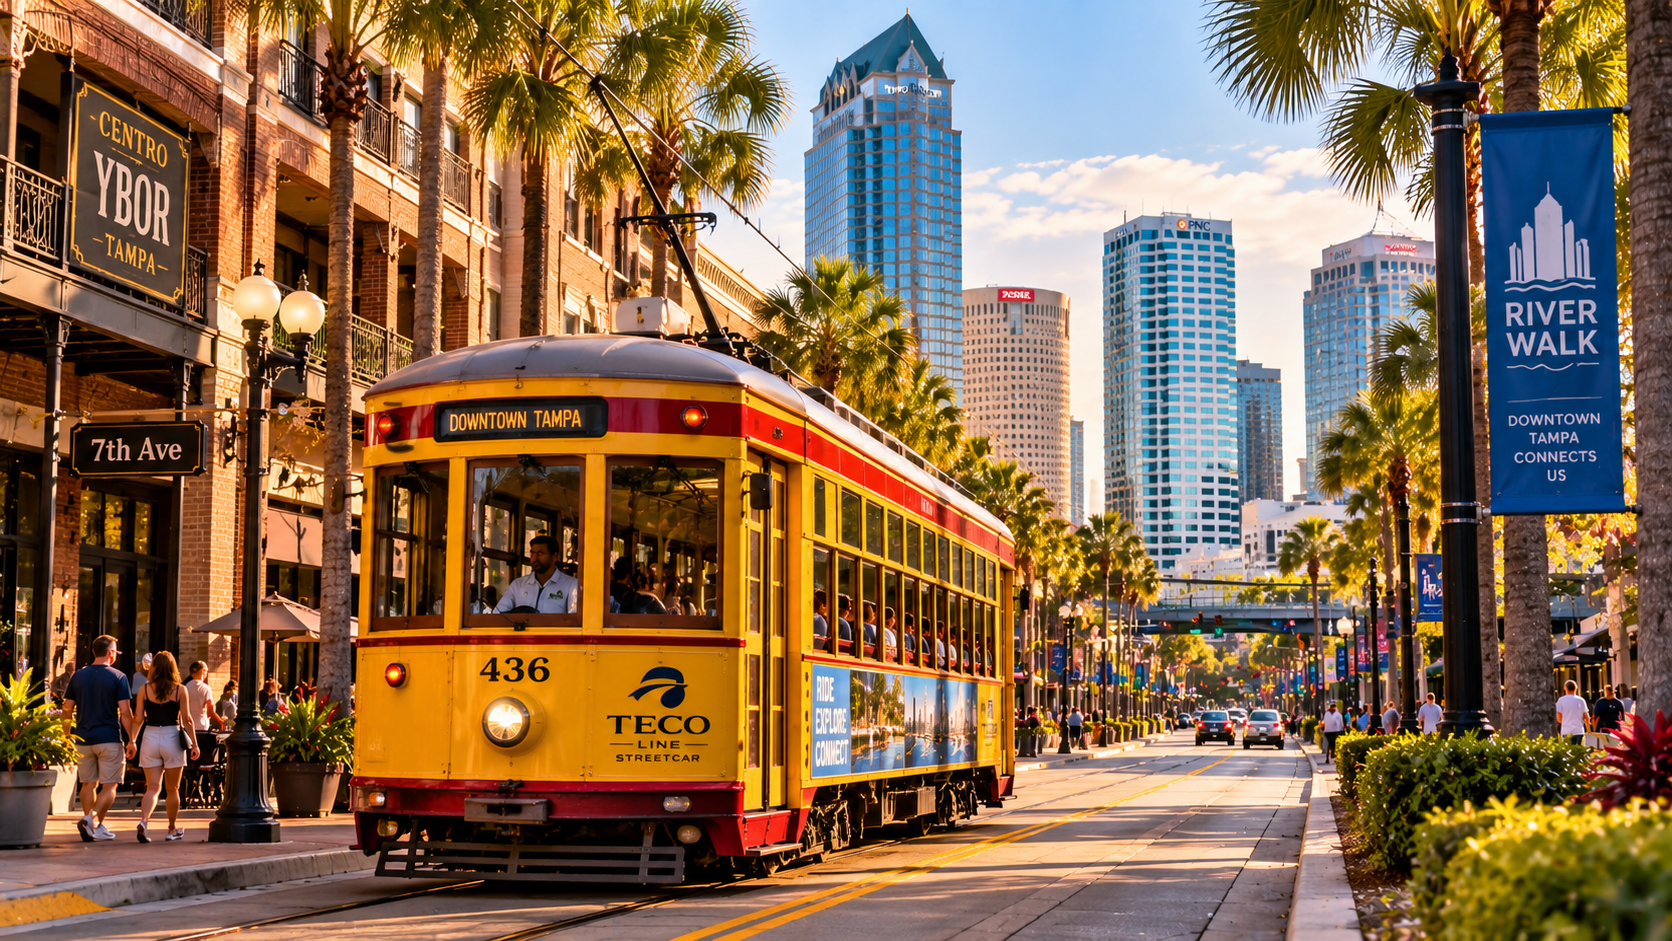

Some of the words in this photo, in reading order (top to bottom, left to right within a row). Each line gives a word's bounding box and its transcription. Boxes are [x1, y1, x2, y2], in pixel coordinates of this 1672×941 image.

[99, 111, 168, 168] CENTRO
[93, 150, 170, 247] YBOR
[1188, 220, 1211, 231] PNC
[1505, 299, 1598, 327] RIVER
[1505, 329, 1599, 357] WALK
[450, 411, 527, 432] DOWNTOWN
[533, 409, 582, 428] TAMPA
[1508, 412, 1601, 427] DOWNTOWN
[91, 437, 131, 461] 7th
[137, 437, 182, 460] Ave
[1529, 431, 1580, 444] TAMPA
[1514, 450, 1597, 464] CONNECTS
[1547, 469, 1567, 481] US
[479, 656, 550, 682] 436
[816, 675, 835, 702] RIDE
[606, 715, 710, 735] TECO
[815, 707, 847, 734] EXPLORE
[638, 740, 680, 749] LINE
[616, 754, 700, 763] STREETCAR
